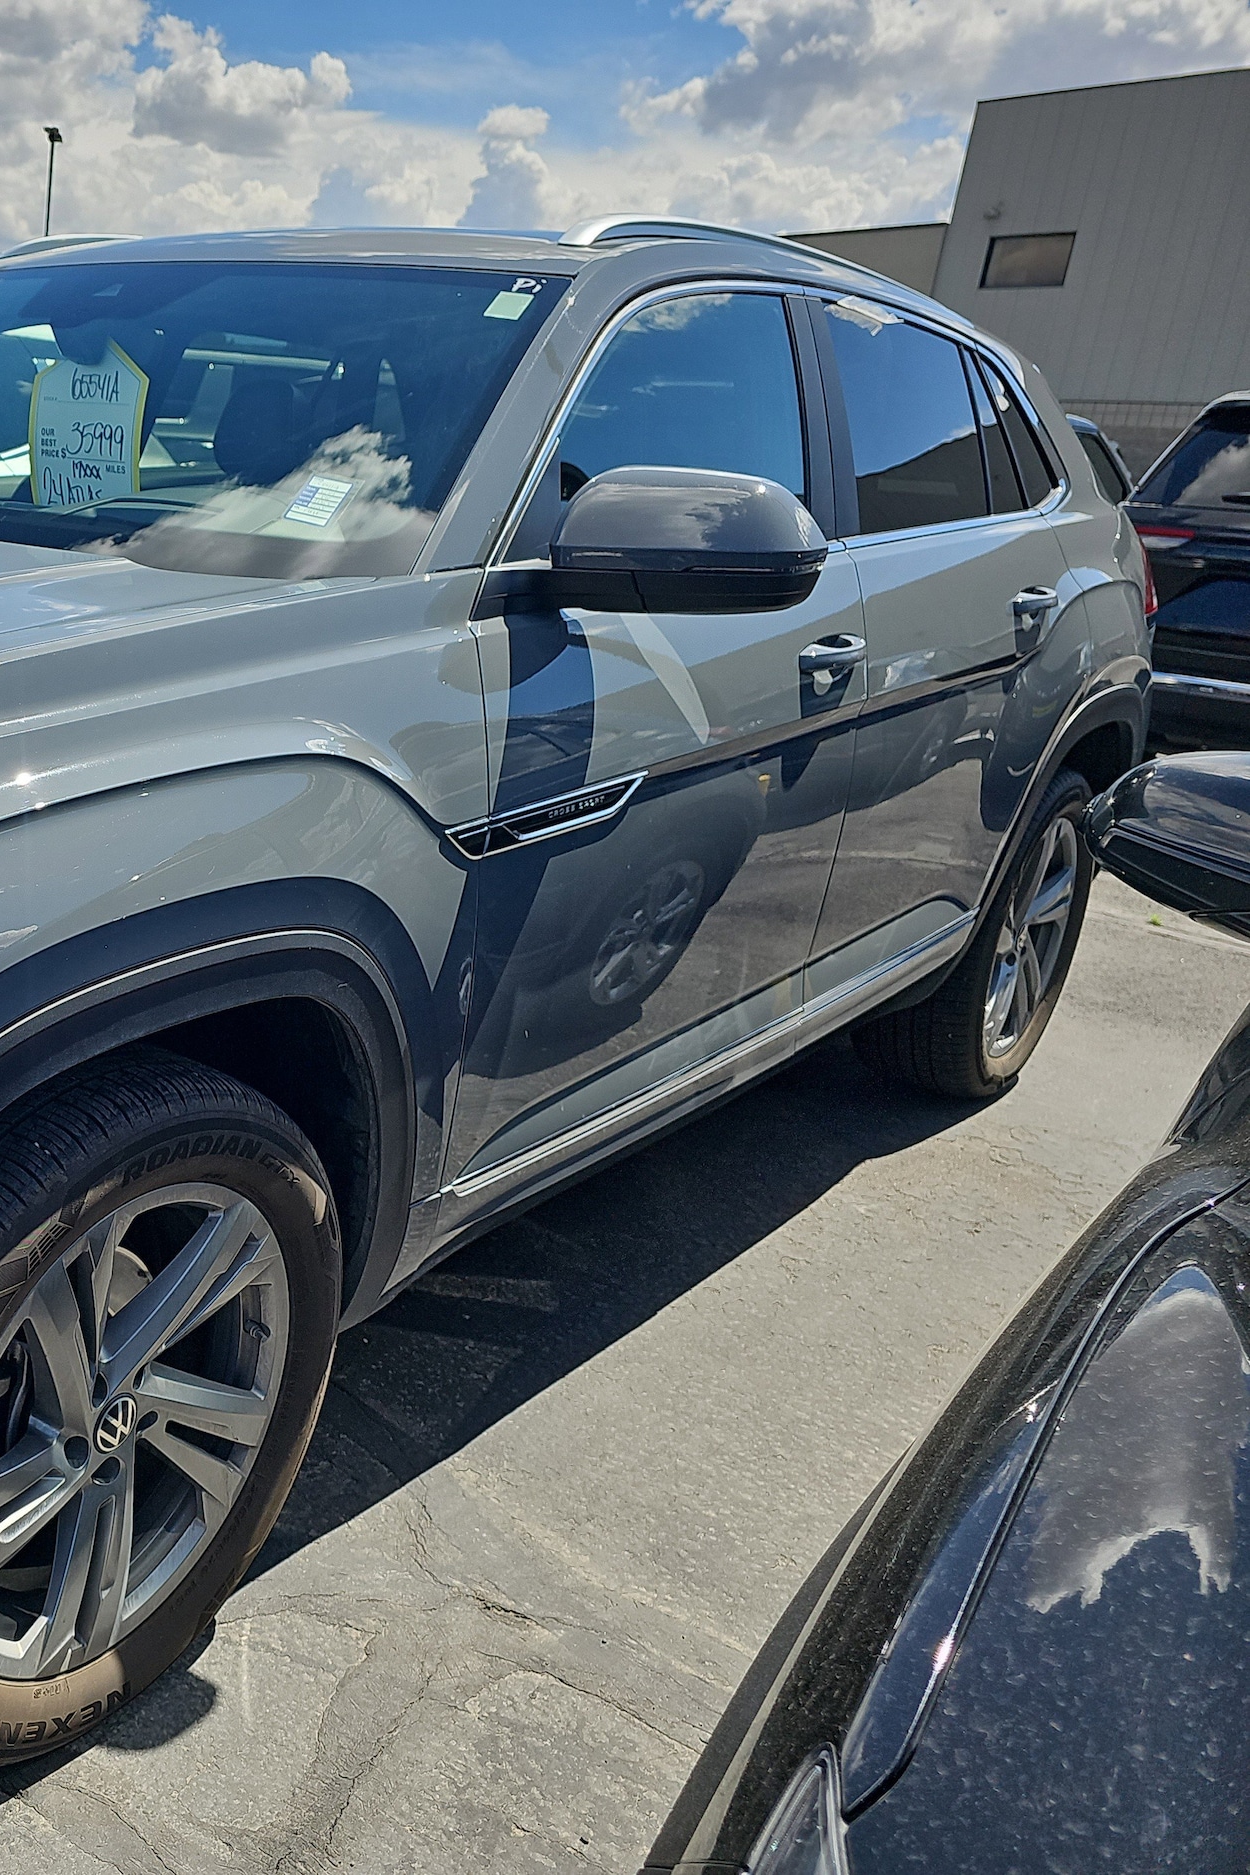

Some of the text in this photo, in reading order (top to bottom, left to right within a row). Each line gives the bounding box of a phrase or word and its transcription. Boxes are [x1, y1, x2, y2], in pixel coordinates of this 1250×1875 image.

[40, 428, 55, 436] OUR
[40, 437, 57, 446] BEST
[105, 464, 126, 474] MILES
[121, 1134, 263, 1188] ROADIAN
[95, 1396, 137, 1452] VW
